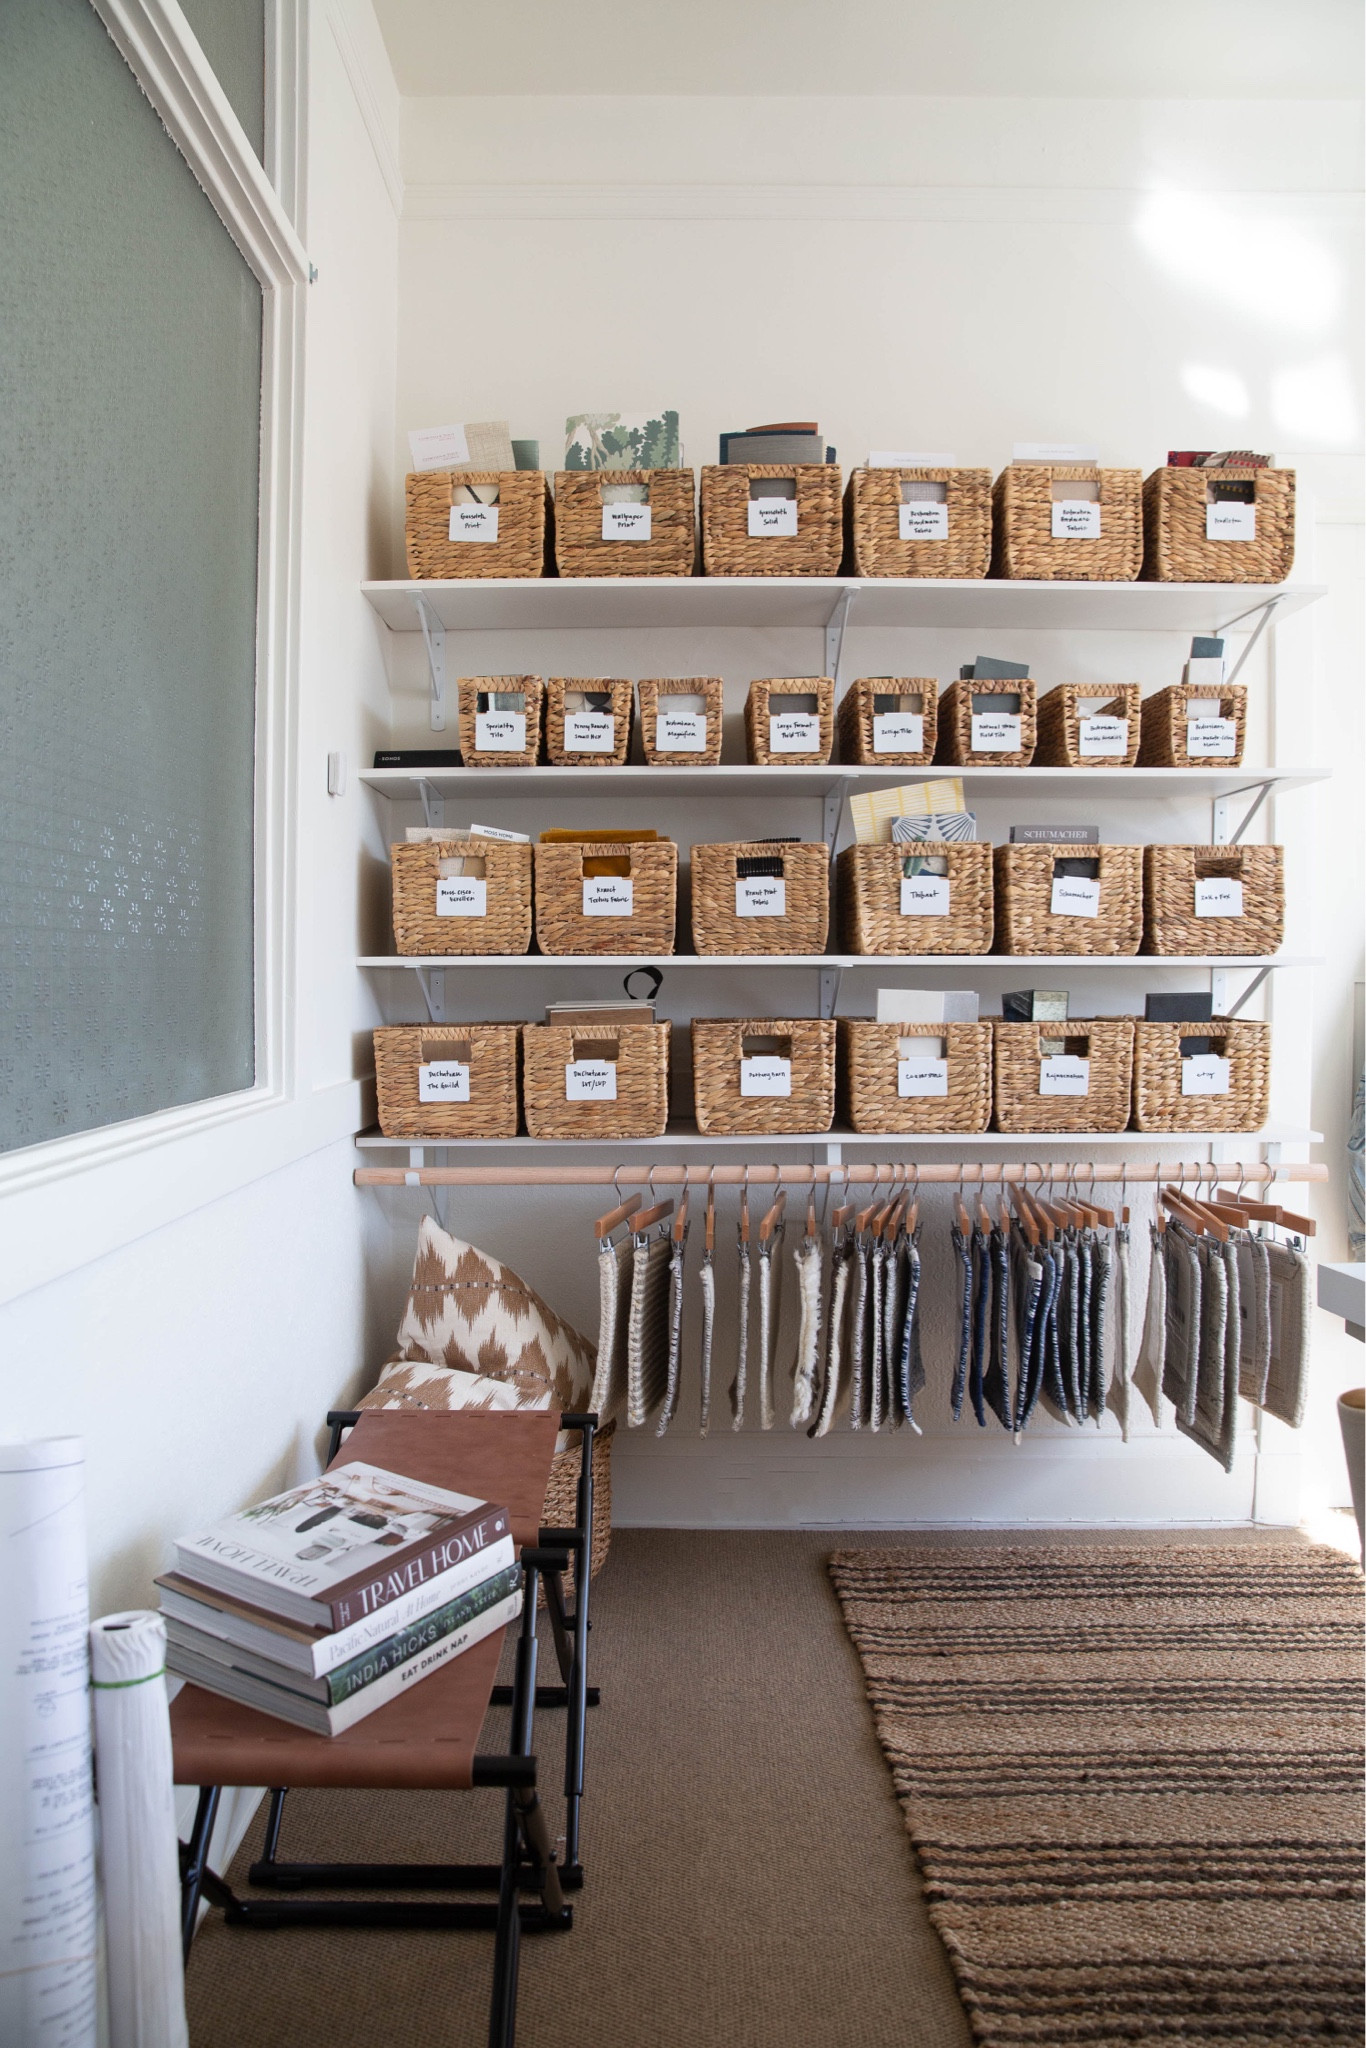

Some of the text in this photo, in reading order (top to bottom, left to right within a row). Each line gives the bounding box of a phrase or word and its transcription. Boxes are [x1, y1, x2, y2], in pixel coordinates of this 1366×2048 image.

[486, 723, 514, 732] Specialty
[484, 828, 498, 837] MOSS
[1024, 830, 1088, 839] SCHUMACHER
[1059, 889, 1094, 899] Schumacher
[358, 1522, 490, 1614] TRAVEL HOME
[330, 1634, 362, 1661] Pacific
[363, 1610, 400, 1642] Natural
[402, 1602, 415, 1619] At
[415, 1589, 441, 1616] Home
[347, 1657, 389, 1690] INDIA
[392, 1624, 438, 1664] HICKS
[402, 1634, 468, 1682] EAT DRINK NAP
